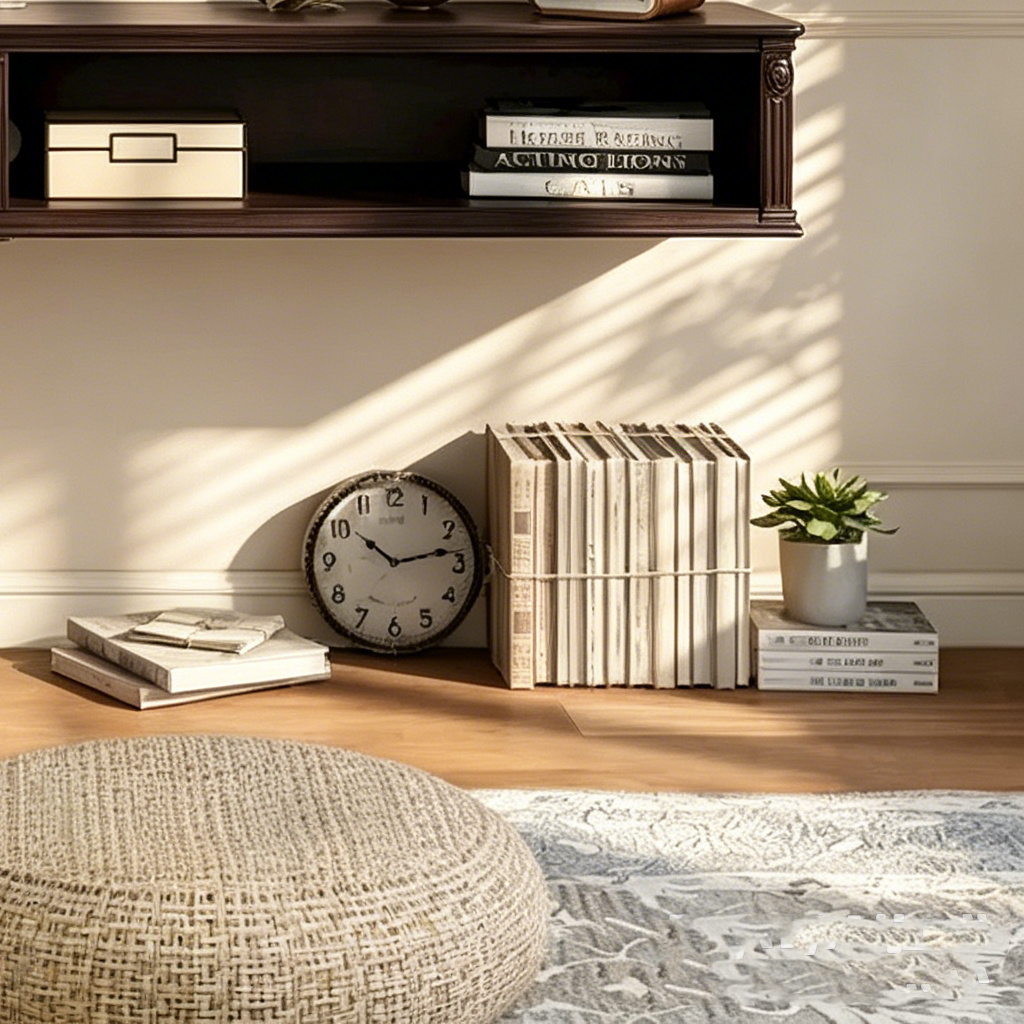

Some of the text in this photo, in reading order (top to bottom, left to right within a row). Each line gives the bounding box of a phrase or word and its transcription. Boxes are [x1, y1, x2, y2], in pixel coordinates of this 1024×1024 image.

[357, 494, 370, 516] 11
[385, 486, 405, 508] 12
[421, 494, 429, 516] 1
[330, 519, 351, 539] 10
[442, 520, 456, 540] 2
[322, 552, 337, 572] 9
[451, 553, 466, 574] 3
[331, 584, 346, 604] 8
[441, 586, 456, 603] 4
[355, 607, 369, 629] 7
[387, 616, 402, 638] 6
[419, 609, 433, 629] 5
